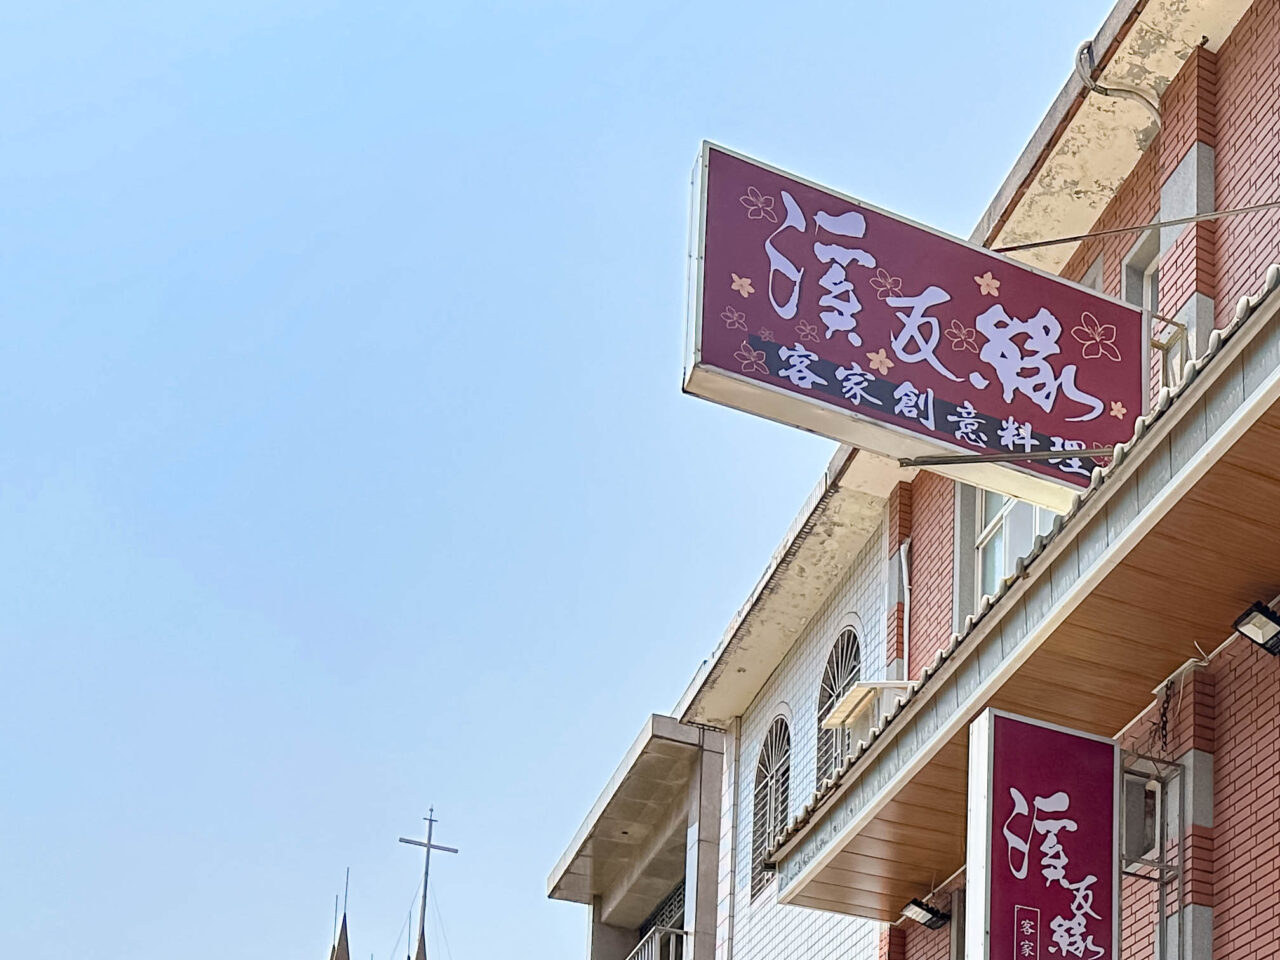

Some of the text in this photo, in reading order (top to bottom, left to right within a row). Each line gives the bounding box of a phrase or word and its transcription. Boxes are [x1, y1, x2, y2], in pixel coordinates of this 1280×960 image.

[776, 342, 1091, 477] 客家創意料理
